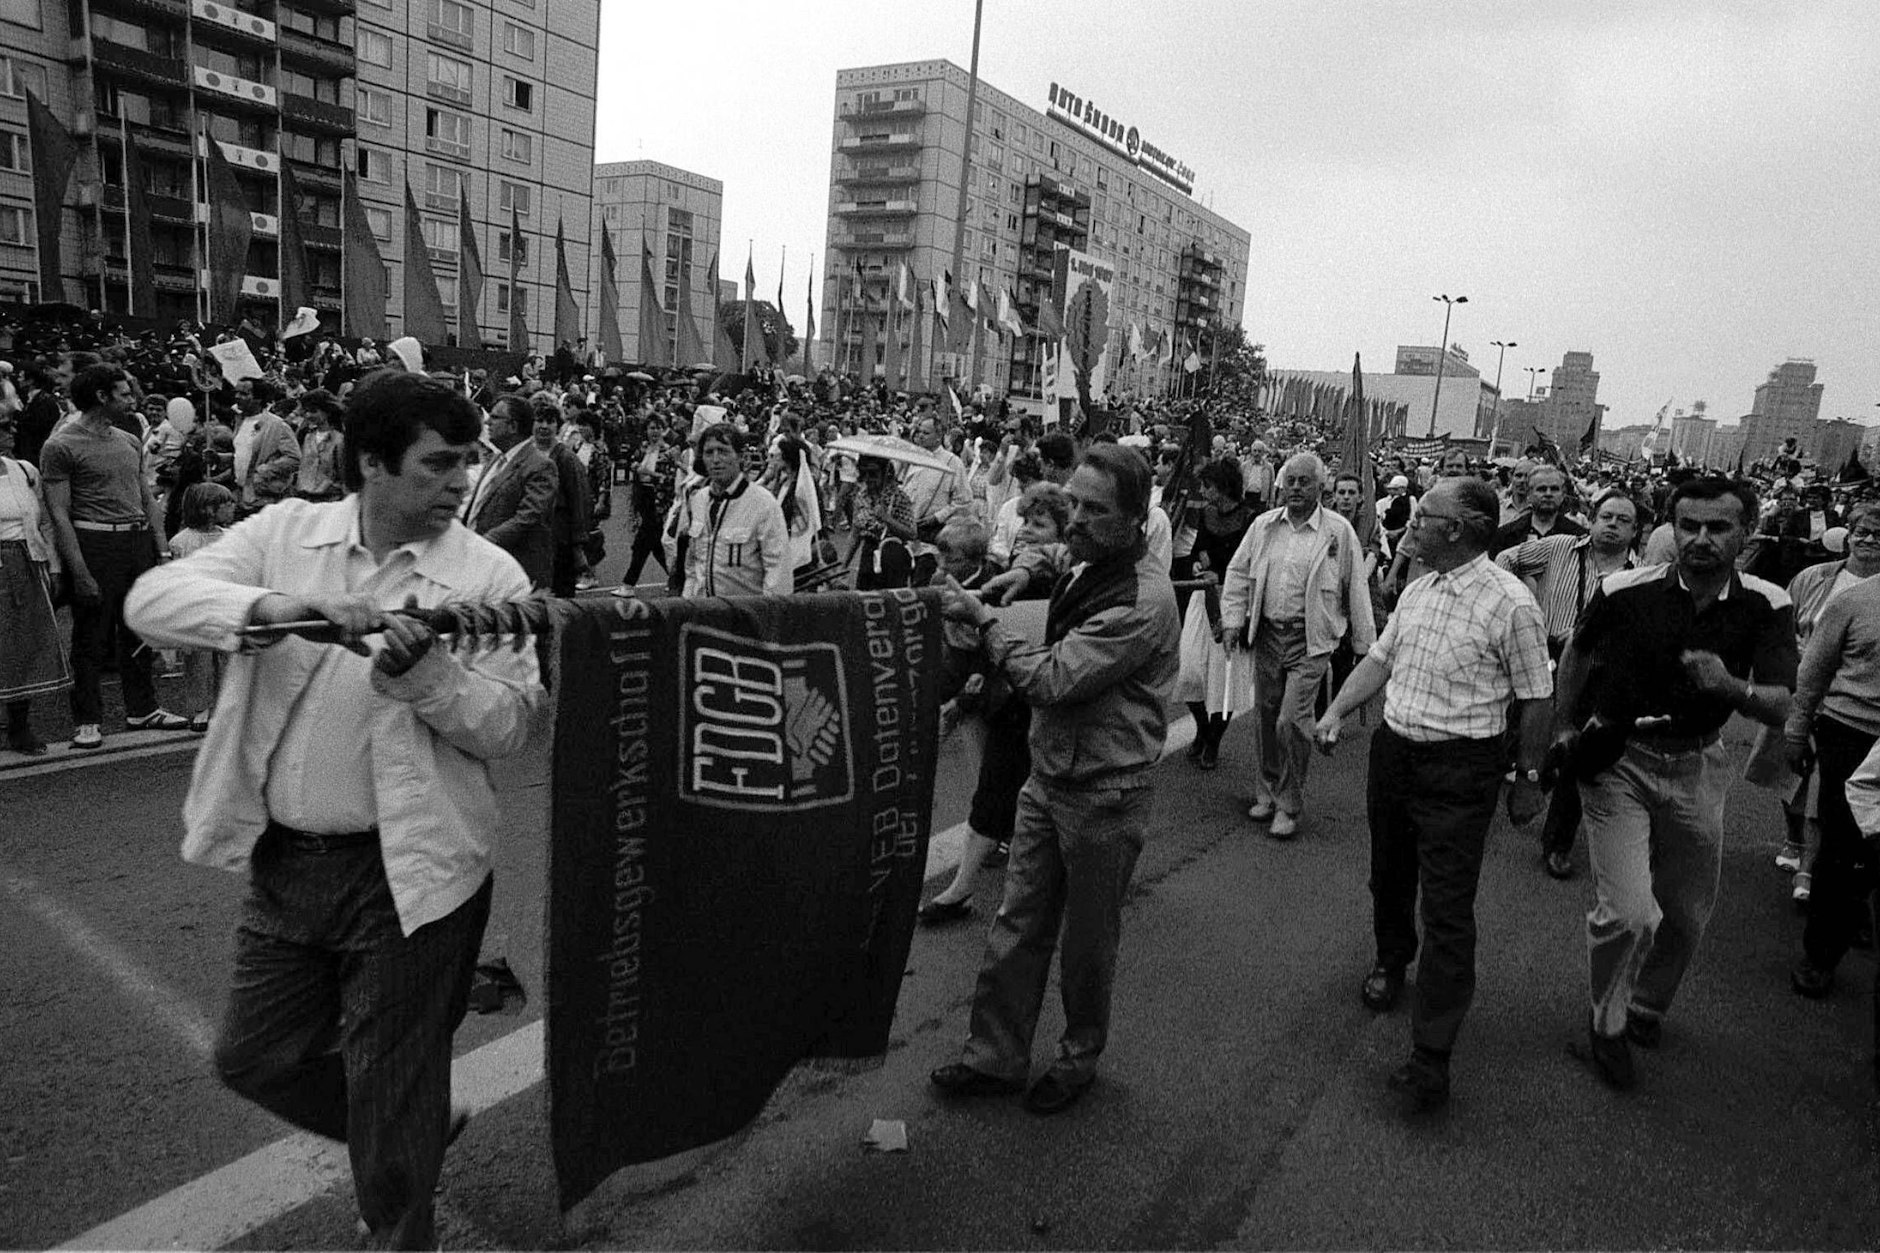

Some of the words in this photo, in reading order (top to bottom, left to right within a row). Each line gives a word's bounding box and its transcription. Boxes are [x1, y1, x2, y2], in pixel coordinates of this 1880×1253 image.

[1084, 100, 1125, 143] ŠKODA
[692, 646, 785, 801] FDGB
[867, 807, 900, 893] VEB
